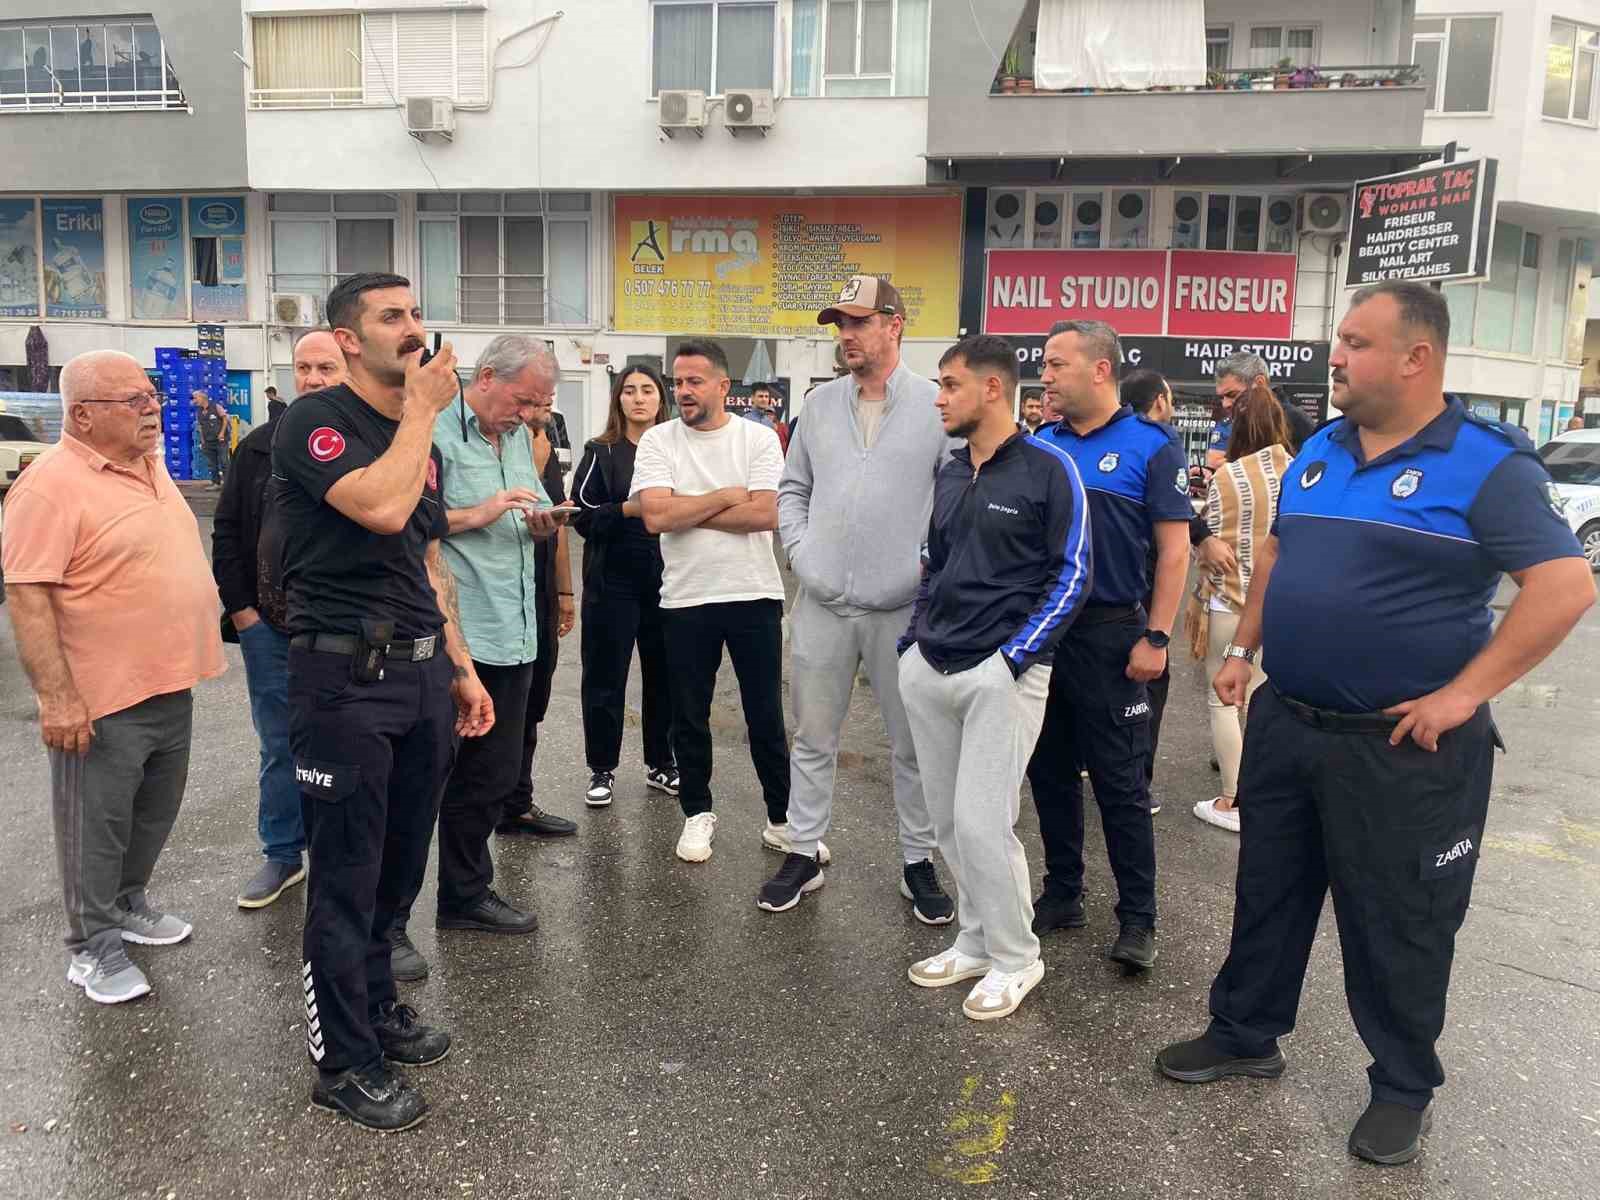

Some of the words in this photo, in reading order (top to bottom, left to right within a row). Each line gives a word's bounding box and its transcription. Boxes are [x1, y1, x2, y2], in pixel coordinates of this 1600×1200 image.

[1375, 176, 1438, 201] TOPRAK
[1378, 196, 1427, 216] WOMAN
[1442, 191, 1471, 206] MAN
[1384, 211, 1436, 229] FRISEUR
[1366, 222, 1453, 244] HAIRDRESSER
[1359, 241, 1405, 257] BEAUTY
[1408, 234, 1459, 253] CENTER
[634, 264, 664, 273] BELEK
[1379, 256, 1406, 268] NAIL
[1408, 251, 1433, 265] ART
[1361, 269, 1388, 282] SILK
[1389, 262, 1451, 279] EYELAHES
[993, 275, 1052, 308] NAIL
[1060, 276, 1160, 309] STUDIO
[1175, 275, 1287, 313] FRISEUR
[1185, 343, 1233, 358] HAIR
[1178, 419, 1216, 428] FRISEUR
[1435, 838, 1472, 867] ZABITA
